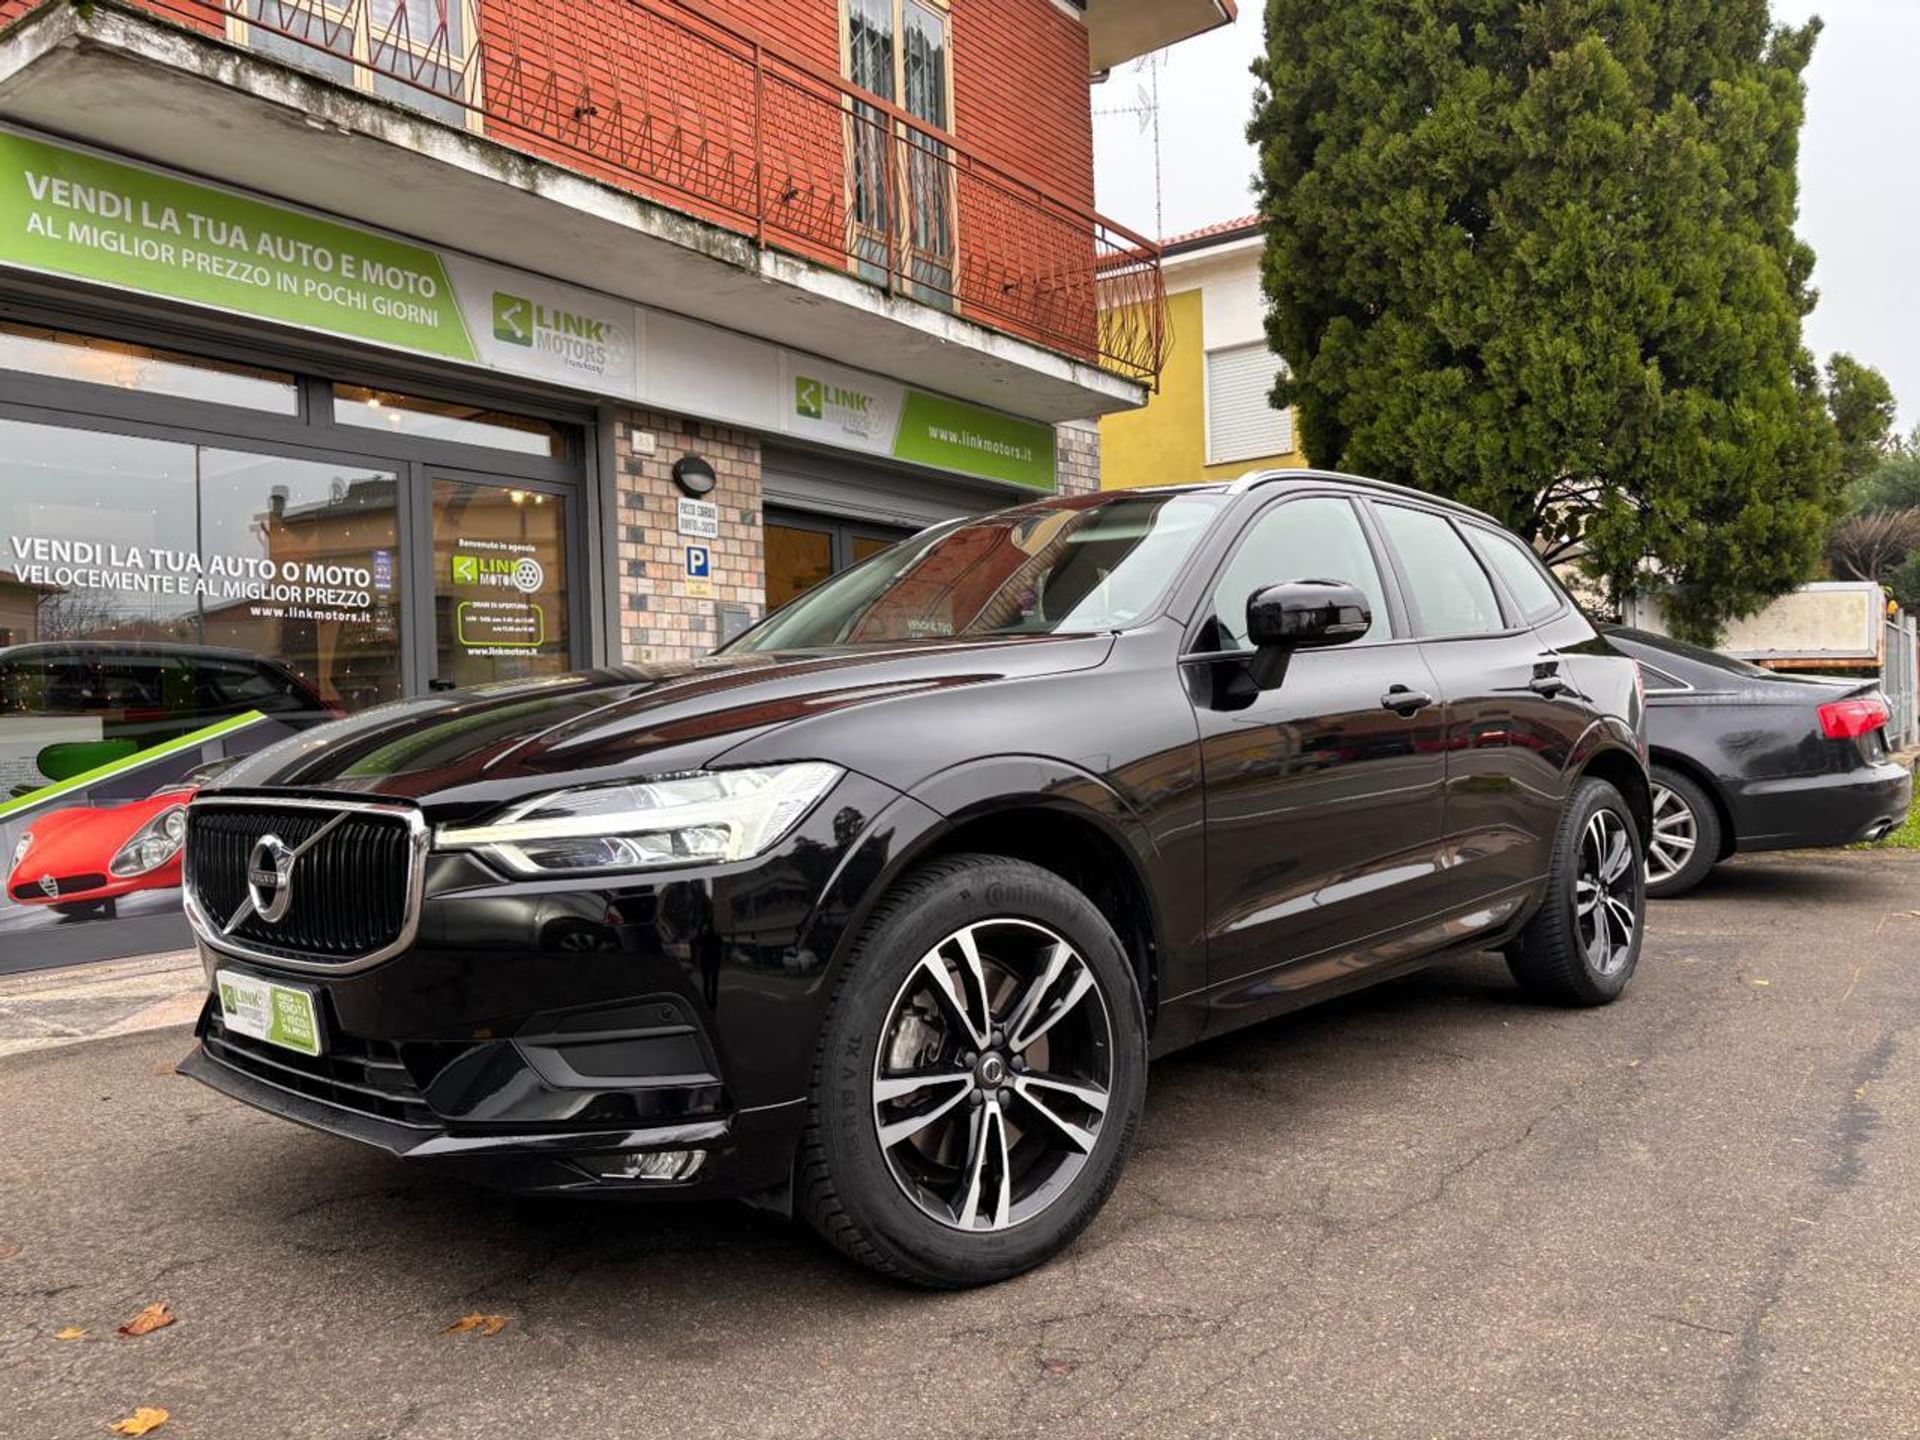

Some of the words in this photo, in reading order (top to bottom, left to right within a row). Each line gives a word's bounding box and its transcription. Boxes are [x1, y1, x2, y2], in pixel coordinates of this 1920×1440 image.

[25, 171, 131, 222] VENDI
[142, 201, 181, 235] LA
[187, 213, 249, 253] TUA
[256, 232, 333, 273] AUTO
[341, 254, 355, 277] E
[362, 261, 436, 299] MOTO
[26, 212, 61, 240] AL
[68, 222, 175, 265] MIGLIOR
[182, 251, 270, 287] PREZZO
[276, 271, 298, 293] IN
[304, 278, 367, 310] POCHI
[371, 296, 439, 328] GIORNI
[535, 305, 604, 343] LINK
[537, 330, 606, 366] MOTORS
[823, 384, 868, 412] LINK
[928, 424, 1032, 462] www.linkmotors.it
[11, 535, 102, 565] VENDI
[110, 545, 144, 570] LA
[149, 548, 202, 574] TUA
[210, 557, 276, 581] AUTO
[282, 561, 300, 582] O
[305, 565, 371, 588] MOTO
[458, 538, 499, 550] Benvenuto
[690, 549, 705, 574] P
[14, 563, 174, 595] VELOCEMENTE
[179, 577, 190, 595] E
[194, 578, 219, 597] AL
[223, 580, 301, 602] MIGLIOR
[305, 588, 370, 608] PREZZO
[250, 604, 371, 623] www.linkmotors.it
